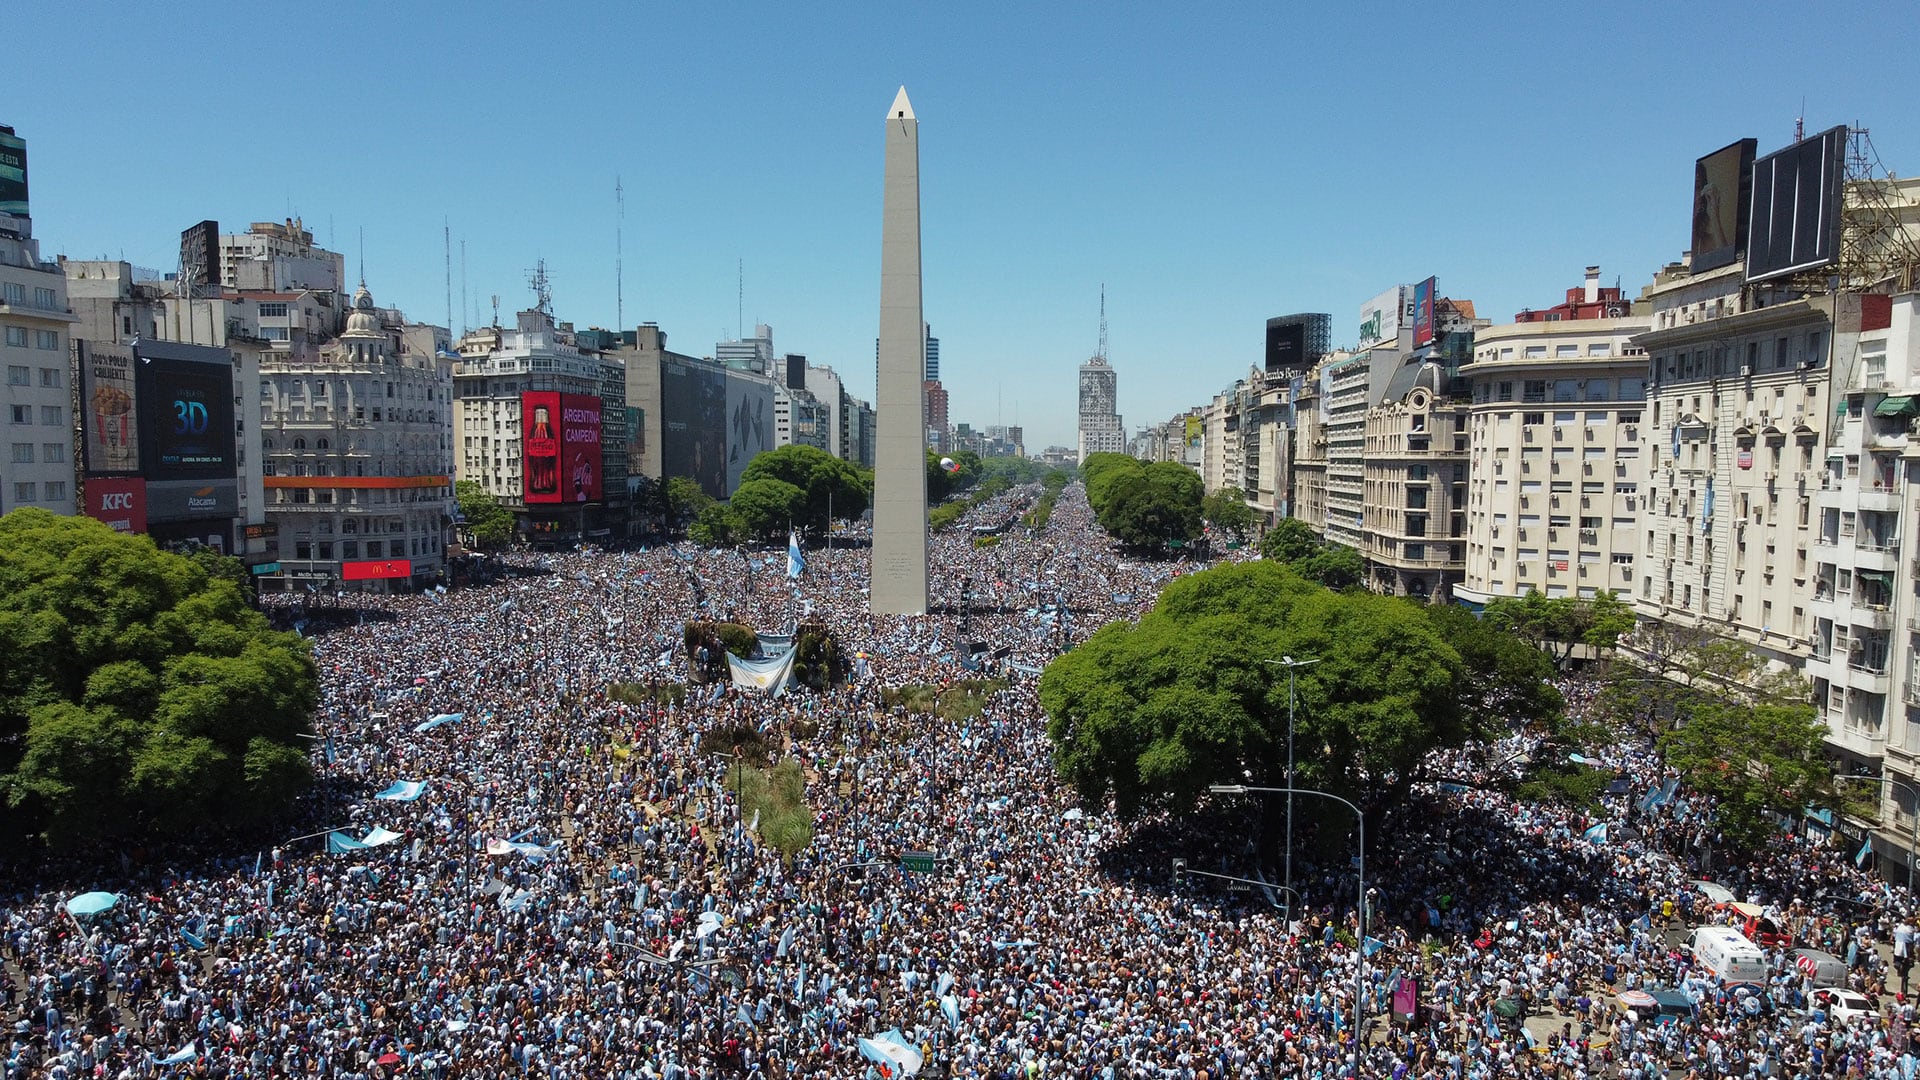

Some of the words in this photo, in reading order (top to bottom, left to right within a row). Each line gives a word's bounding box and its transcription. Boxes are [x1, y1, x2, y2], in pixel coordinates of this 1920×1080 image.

[109, 354, 128, 368] POLLO
[174, 400, 208, 435] 3D
[564, 408, 601, 424] ARGENTINA
[566, 427, 598, 443] CAMPEÓN
[102, 493, 133, 511] KFC
[188, 496, 217, 506] Atacama
